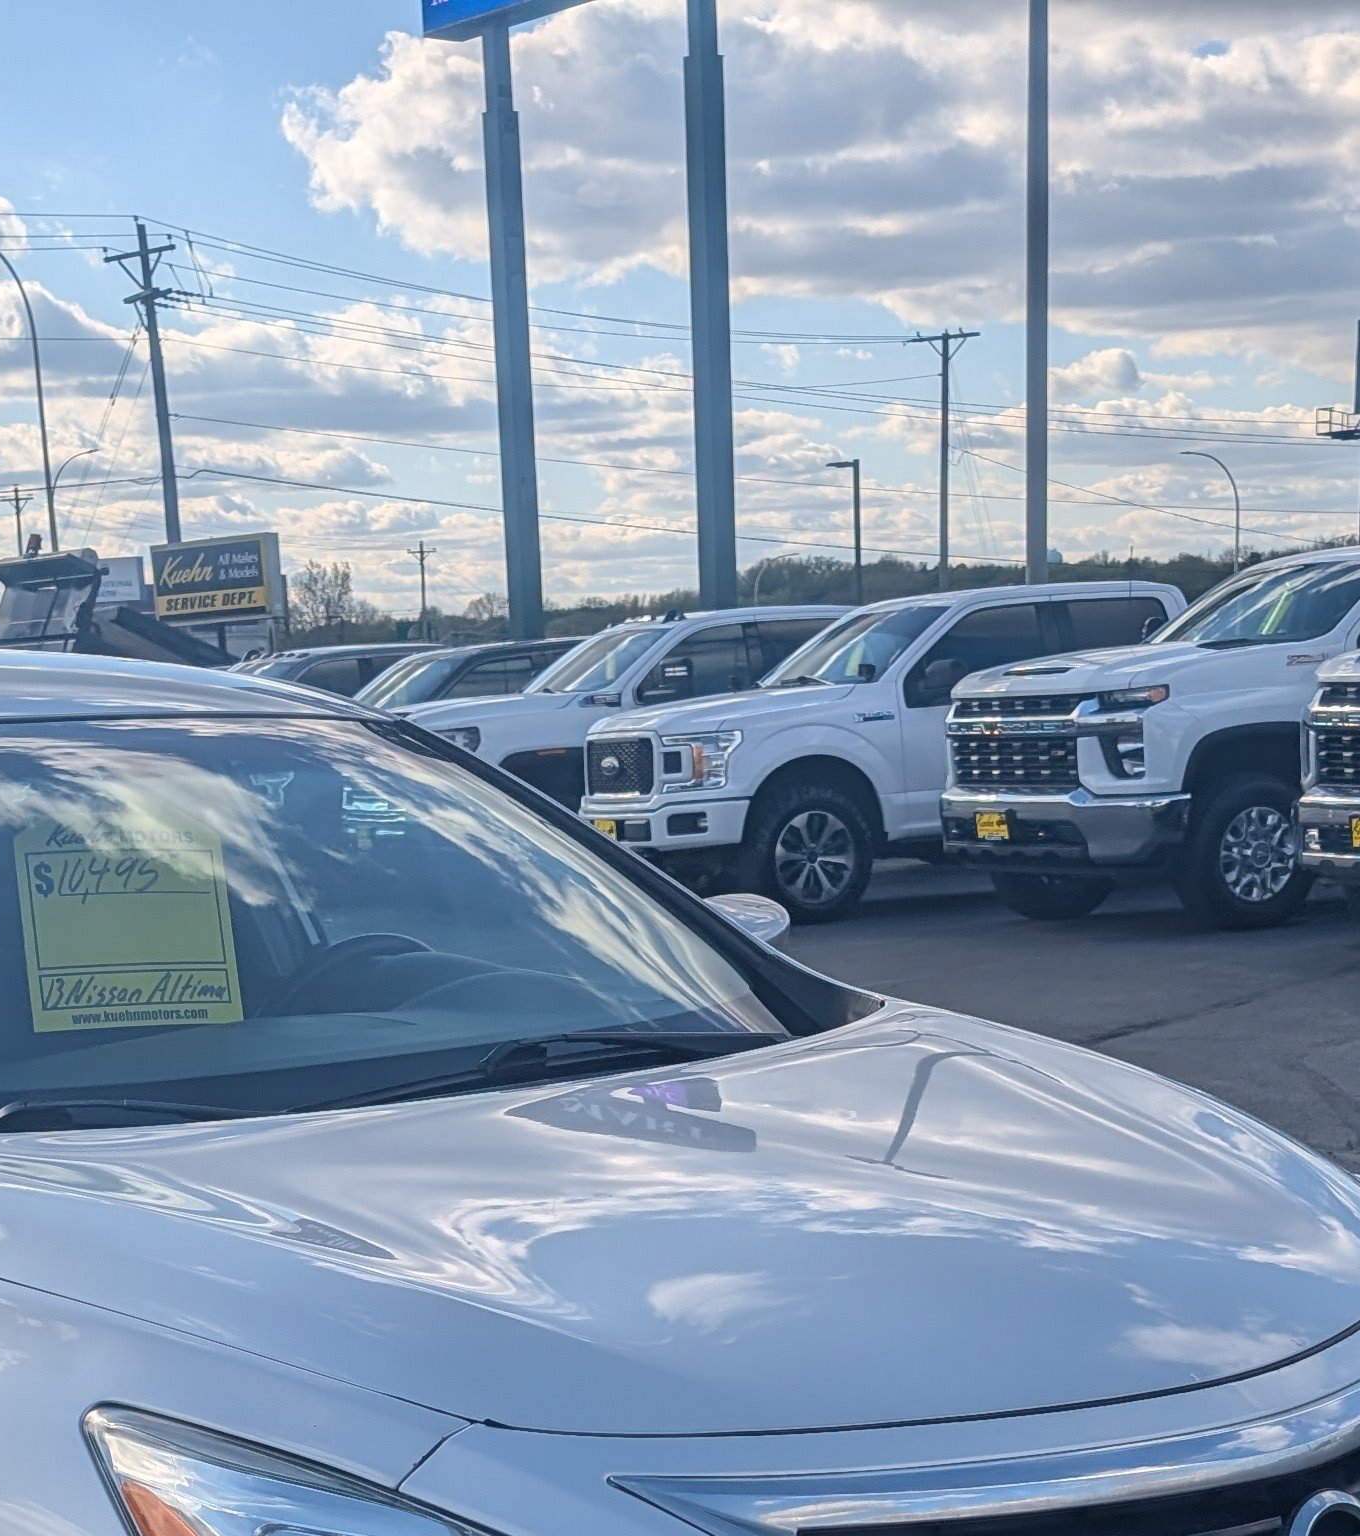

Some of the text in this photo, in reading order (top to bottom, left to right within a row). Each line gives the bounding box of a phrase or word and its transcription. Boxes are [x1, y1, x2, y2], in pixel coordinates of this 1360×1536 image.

[218, 551, 259, 565] All Makes
[159, 552, 214, 589] Kuehn
[228, 565, 259, 579] Models
[166, 591, 258, 612] SERVICE DEPT.
[65, 975, 143, 1006] Nissan
[145, 971, 227, 1002] Altima
[71, 1008, 209, 1025] www.kuehnmotors.com
